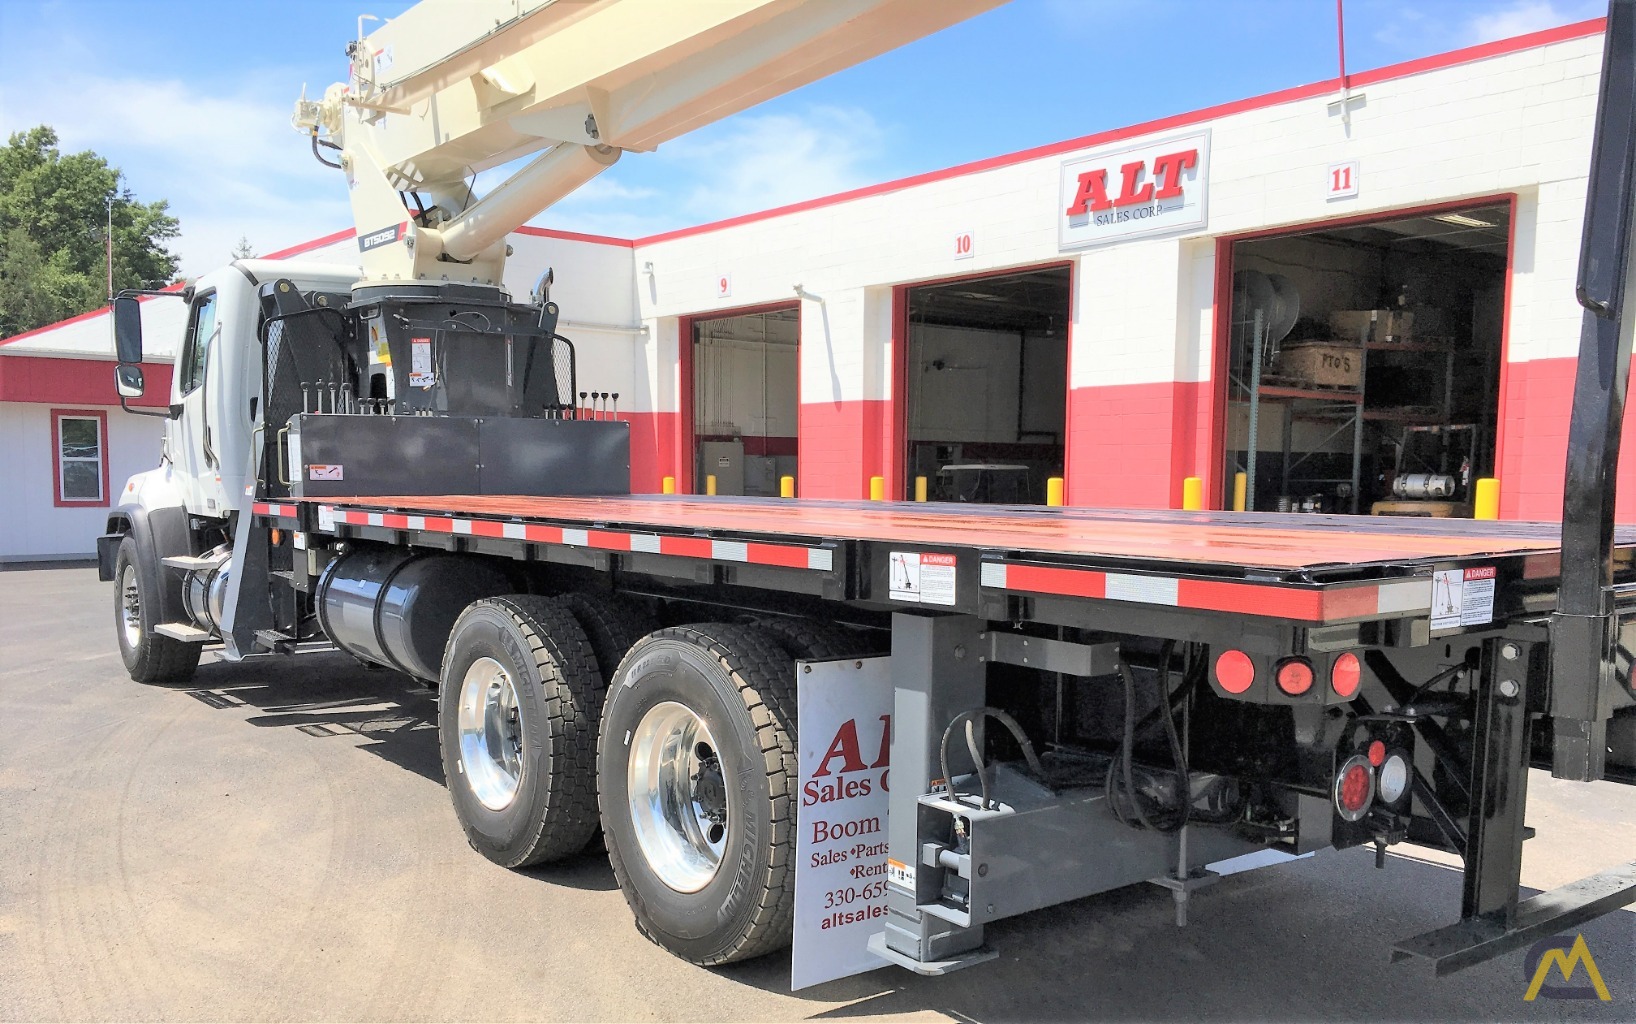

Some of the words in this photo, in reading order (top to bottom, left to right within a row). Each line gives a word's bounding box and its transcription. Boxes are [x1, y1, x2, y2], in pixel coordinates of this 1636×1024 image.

[1066, 149, 1198, 216] ALT
[1332, 166, 1352, 192] 11
[1096, 210, 1130, 227] SALES
[956, 234, 971, 254] 10
[720, 277, 727, 293] 9
[928, 555, 953, 564] DANGER
[1471, 568, 1494, 578] DANGER
[803, 776, 871, 807] Sales
[811, 817, 881, 845] Boom
[811, 849, 848, 868] Sales
